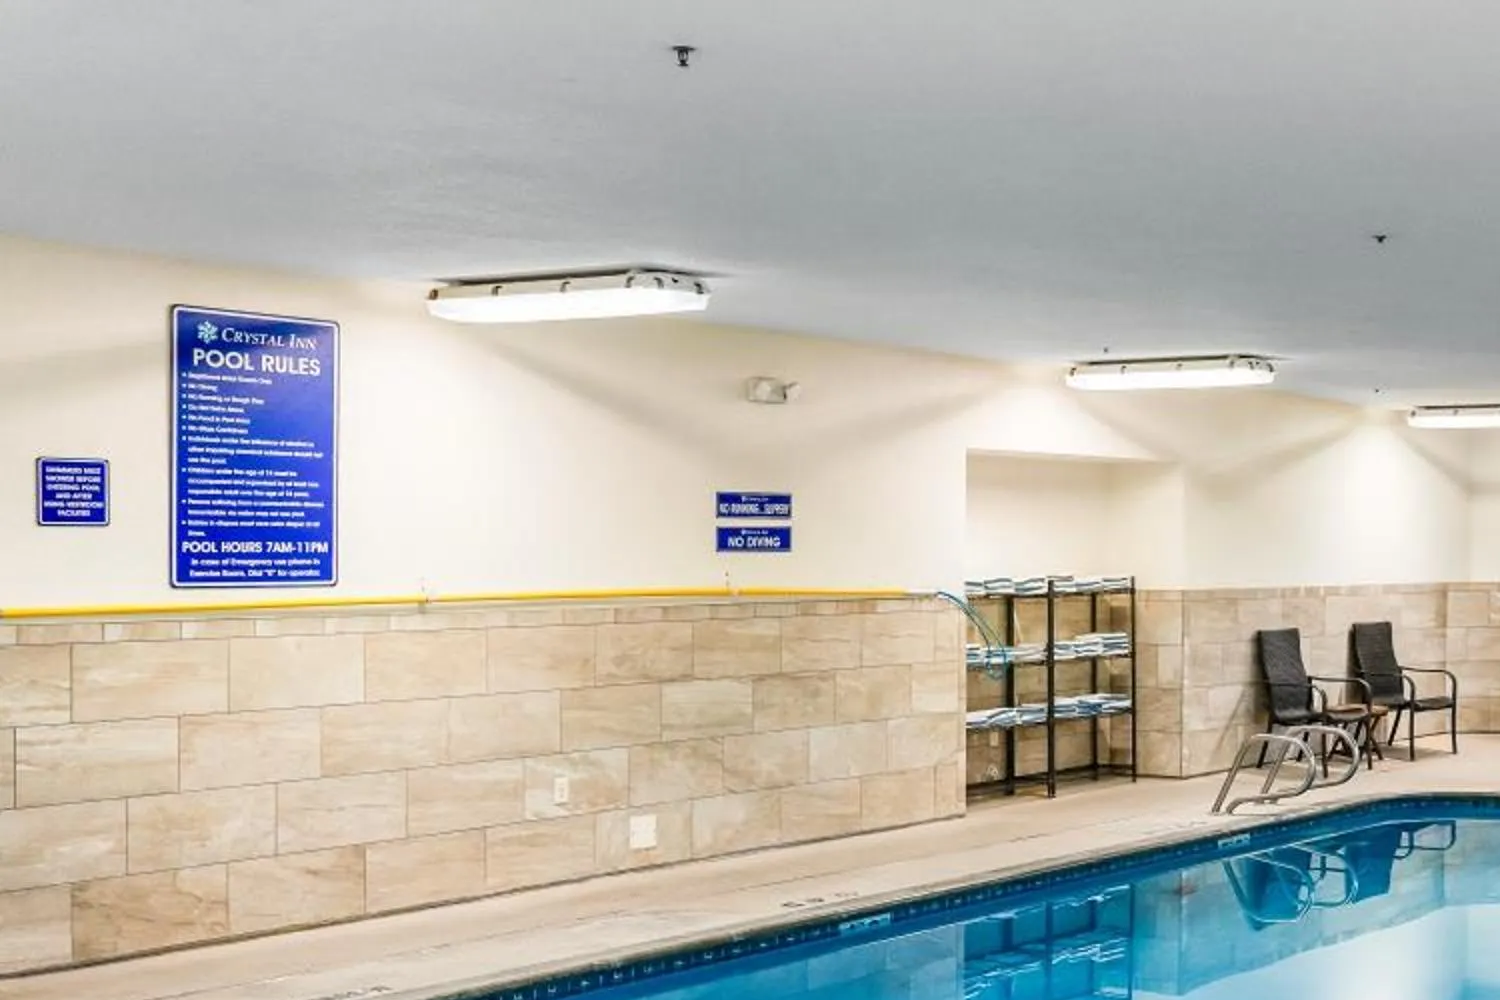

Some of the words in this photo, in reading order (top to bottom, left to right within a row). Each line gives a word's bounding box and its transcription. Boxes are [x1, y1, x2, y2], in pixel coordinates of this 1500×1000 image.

[221, 327, 285, 347] CRYSTAL
[289, 334, 317, 349] INN
[193, 348, 255, 371] POOL
[261, 355, 321, 376] RULES
[181, 541, 218, 553] POOL
[221, 541, 263, 553] HOURS
[266, 541, 329, 553] 7AM-11PM
[727, 536, 744, 547] NO
[747, 536, 781, 548] DIVING
